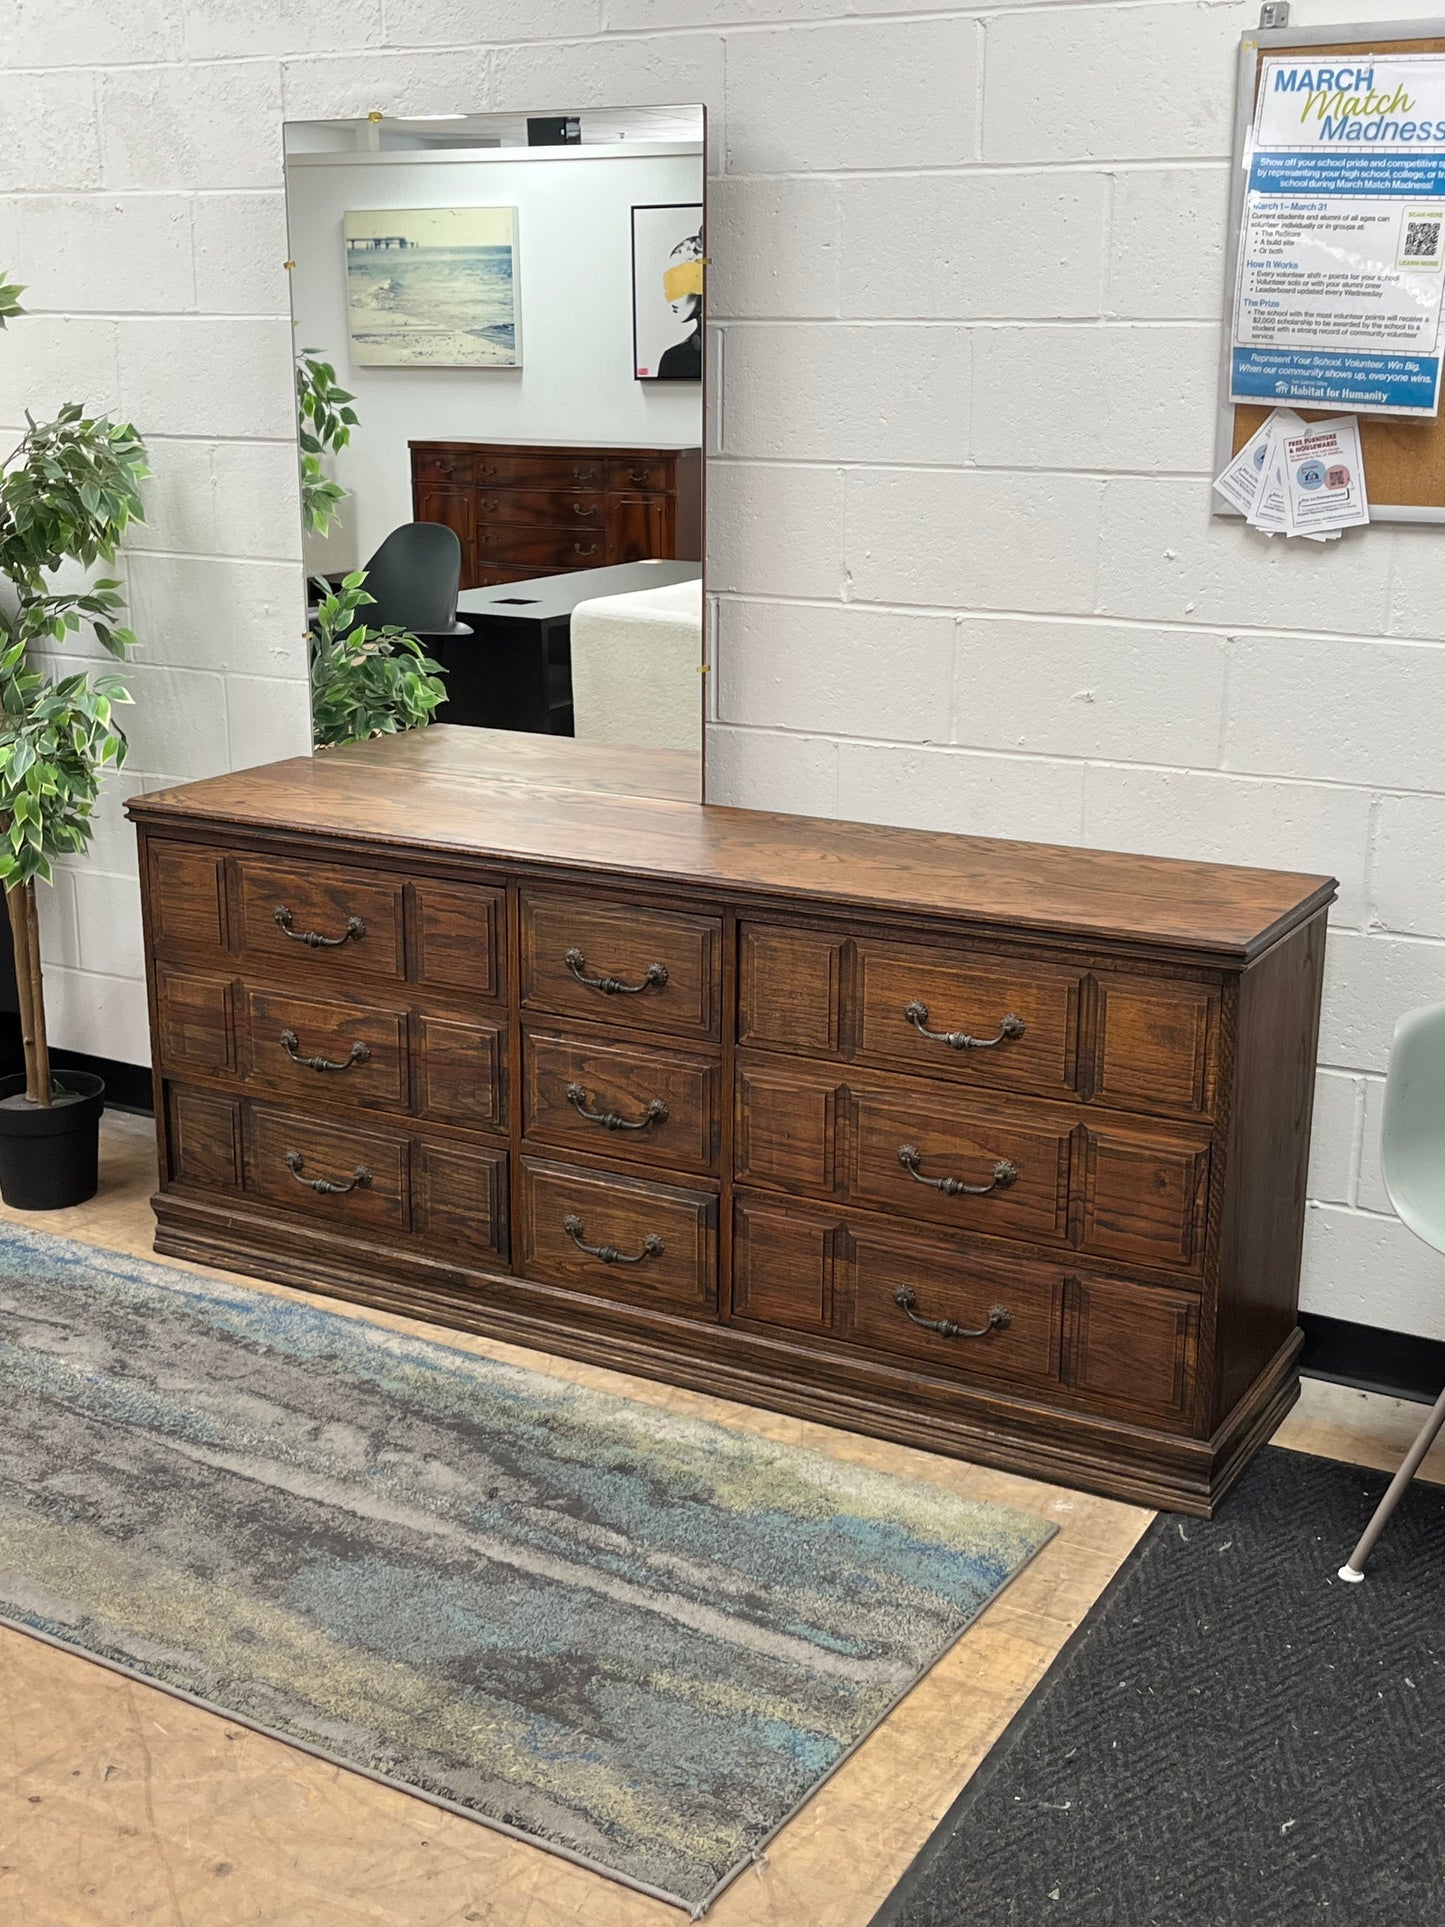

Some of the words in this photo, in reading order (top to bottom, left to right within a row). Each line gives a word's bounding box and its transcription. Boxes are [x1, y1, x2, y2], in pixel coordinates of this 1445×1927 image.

[1275, 69, 1374, 91] MARCH
[1301, 84, 1415, 123] Match
[1319, 115, 1445, 141] Madness
[1260, 158, 1284, 166] Show
[1285, 158, 1297, 166] off
[1298, 160, 1316, 168] your
[1317, 158, 1346, 167] school
[1346, 159, 1369, 168] pride
[1370, 159, 1386, 167] and
[1387, 159, 1437, 169] competitive
[1257, 169, 1267, 178] by
[1268, 169, 1320, 178] representing
[1341, 170, 1359, 179] high
[1361, 170, 1391, 179] school,
[1393, 170, 1426, 179] college,
[1280, 179, 1308, 187] school
[1309, 179, 1335, 189] during
[1336, 180, 1363, 188] March
[1364, 180, 1391, 188] Match
[1392, 180, 1434, 189] Madness!
[1247, 260, 1265, 268] How
[1273, 261, 1299, 269] Works
[1257, 270, 1275, 278] Every
[1345, 289, 1383, 298] Wednesday
[1260, 299, 1280, 307] Prize
[1277, 318, 1313, 326] scholarship
[1350, 330, 1385, 338] community
[1250, 353, 1291, 363] Represent
[1293, 356, 1311, 365] Your
[1313, 357, 1342, 366] School.
[1345, 358, 1385, 369] Volunteer.
[1388, 361, 1403, 370] Win
[1405, 361, 1420, 372] Big.
[1239, 364, 1261, 373] When
[1263, 366, 1276, 374] our
[1278, 367, 1324, 378] community
[1325, 369, 1352, 378] shows
[1354, 372, 1366, 381] up,
[1369, 373, 1408, 382] everyone
[1410, 374, 1432, 383] wins.
[1291, 385, 1324, 396] Habitat
[1327, 388, 1339, 397] for
[1342, 388, 1388, 403] Humanity
[1305, 434, 1336, 444] FURNITURE
[1296, 440, 1337, 452] HOUSEWARES
